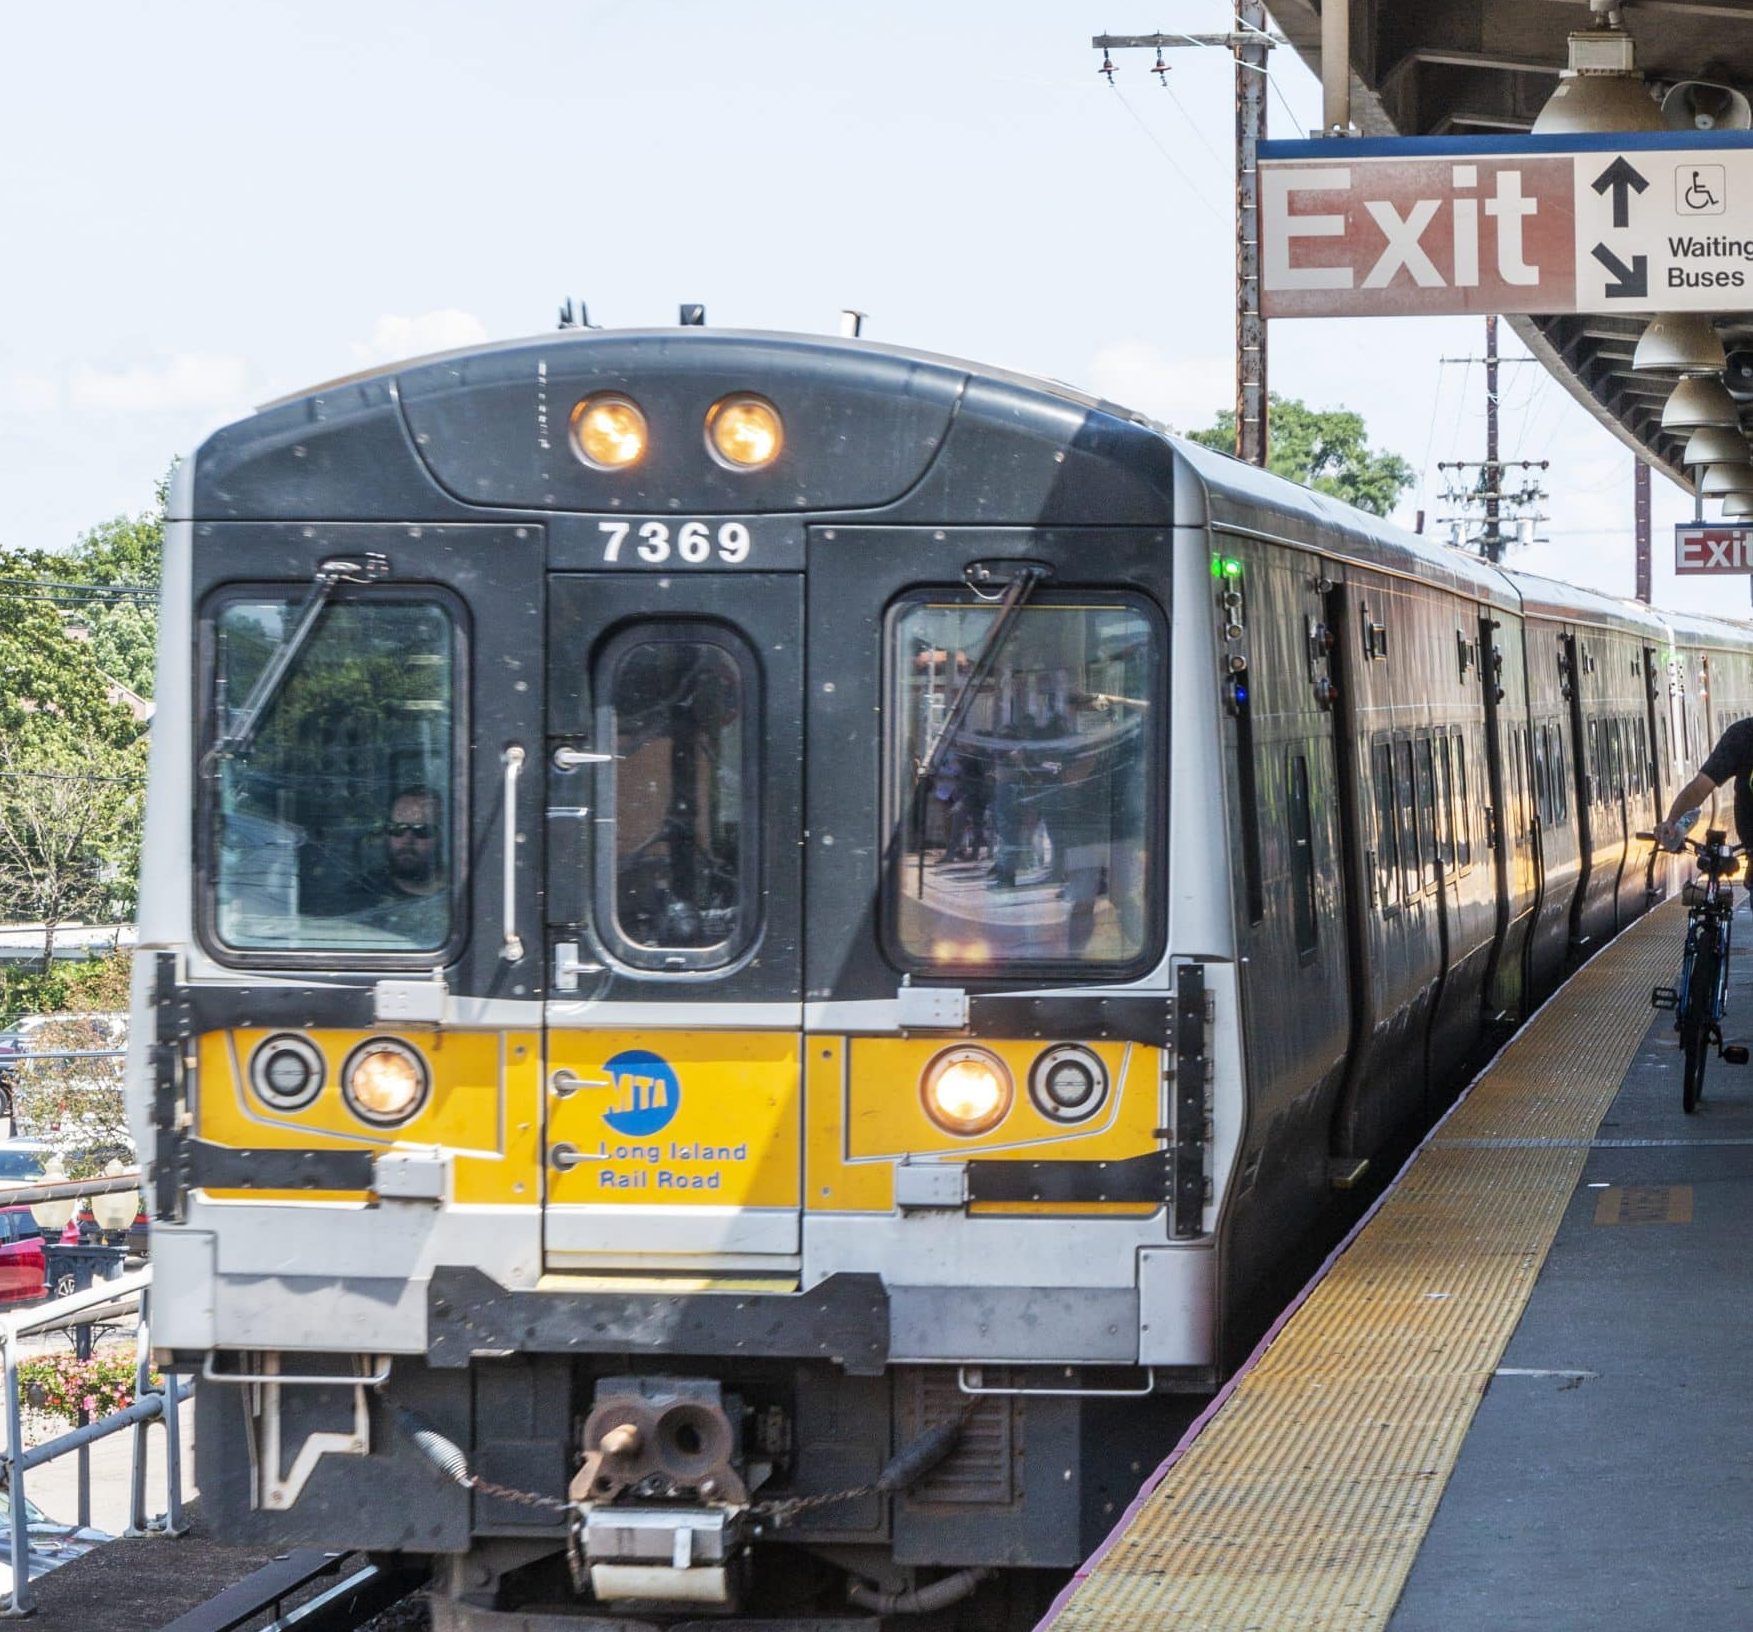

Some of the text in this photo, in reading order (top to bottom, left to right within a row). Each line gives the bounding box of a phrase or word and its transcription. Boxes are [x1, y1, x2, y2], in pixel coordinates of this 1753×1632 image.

[1262, 165, 1540, 290] Exit
[1668, 236, 1753, 261] Waiting
[1668, 267, 1745, 288] Buses
[598, 521, 751, 563] 7369
[600, 1141, 747, 1163] Long Island
[600, 1170, 720, 1188] Rail Road
